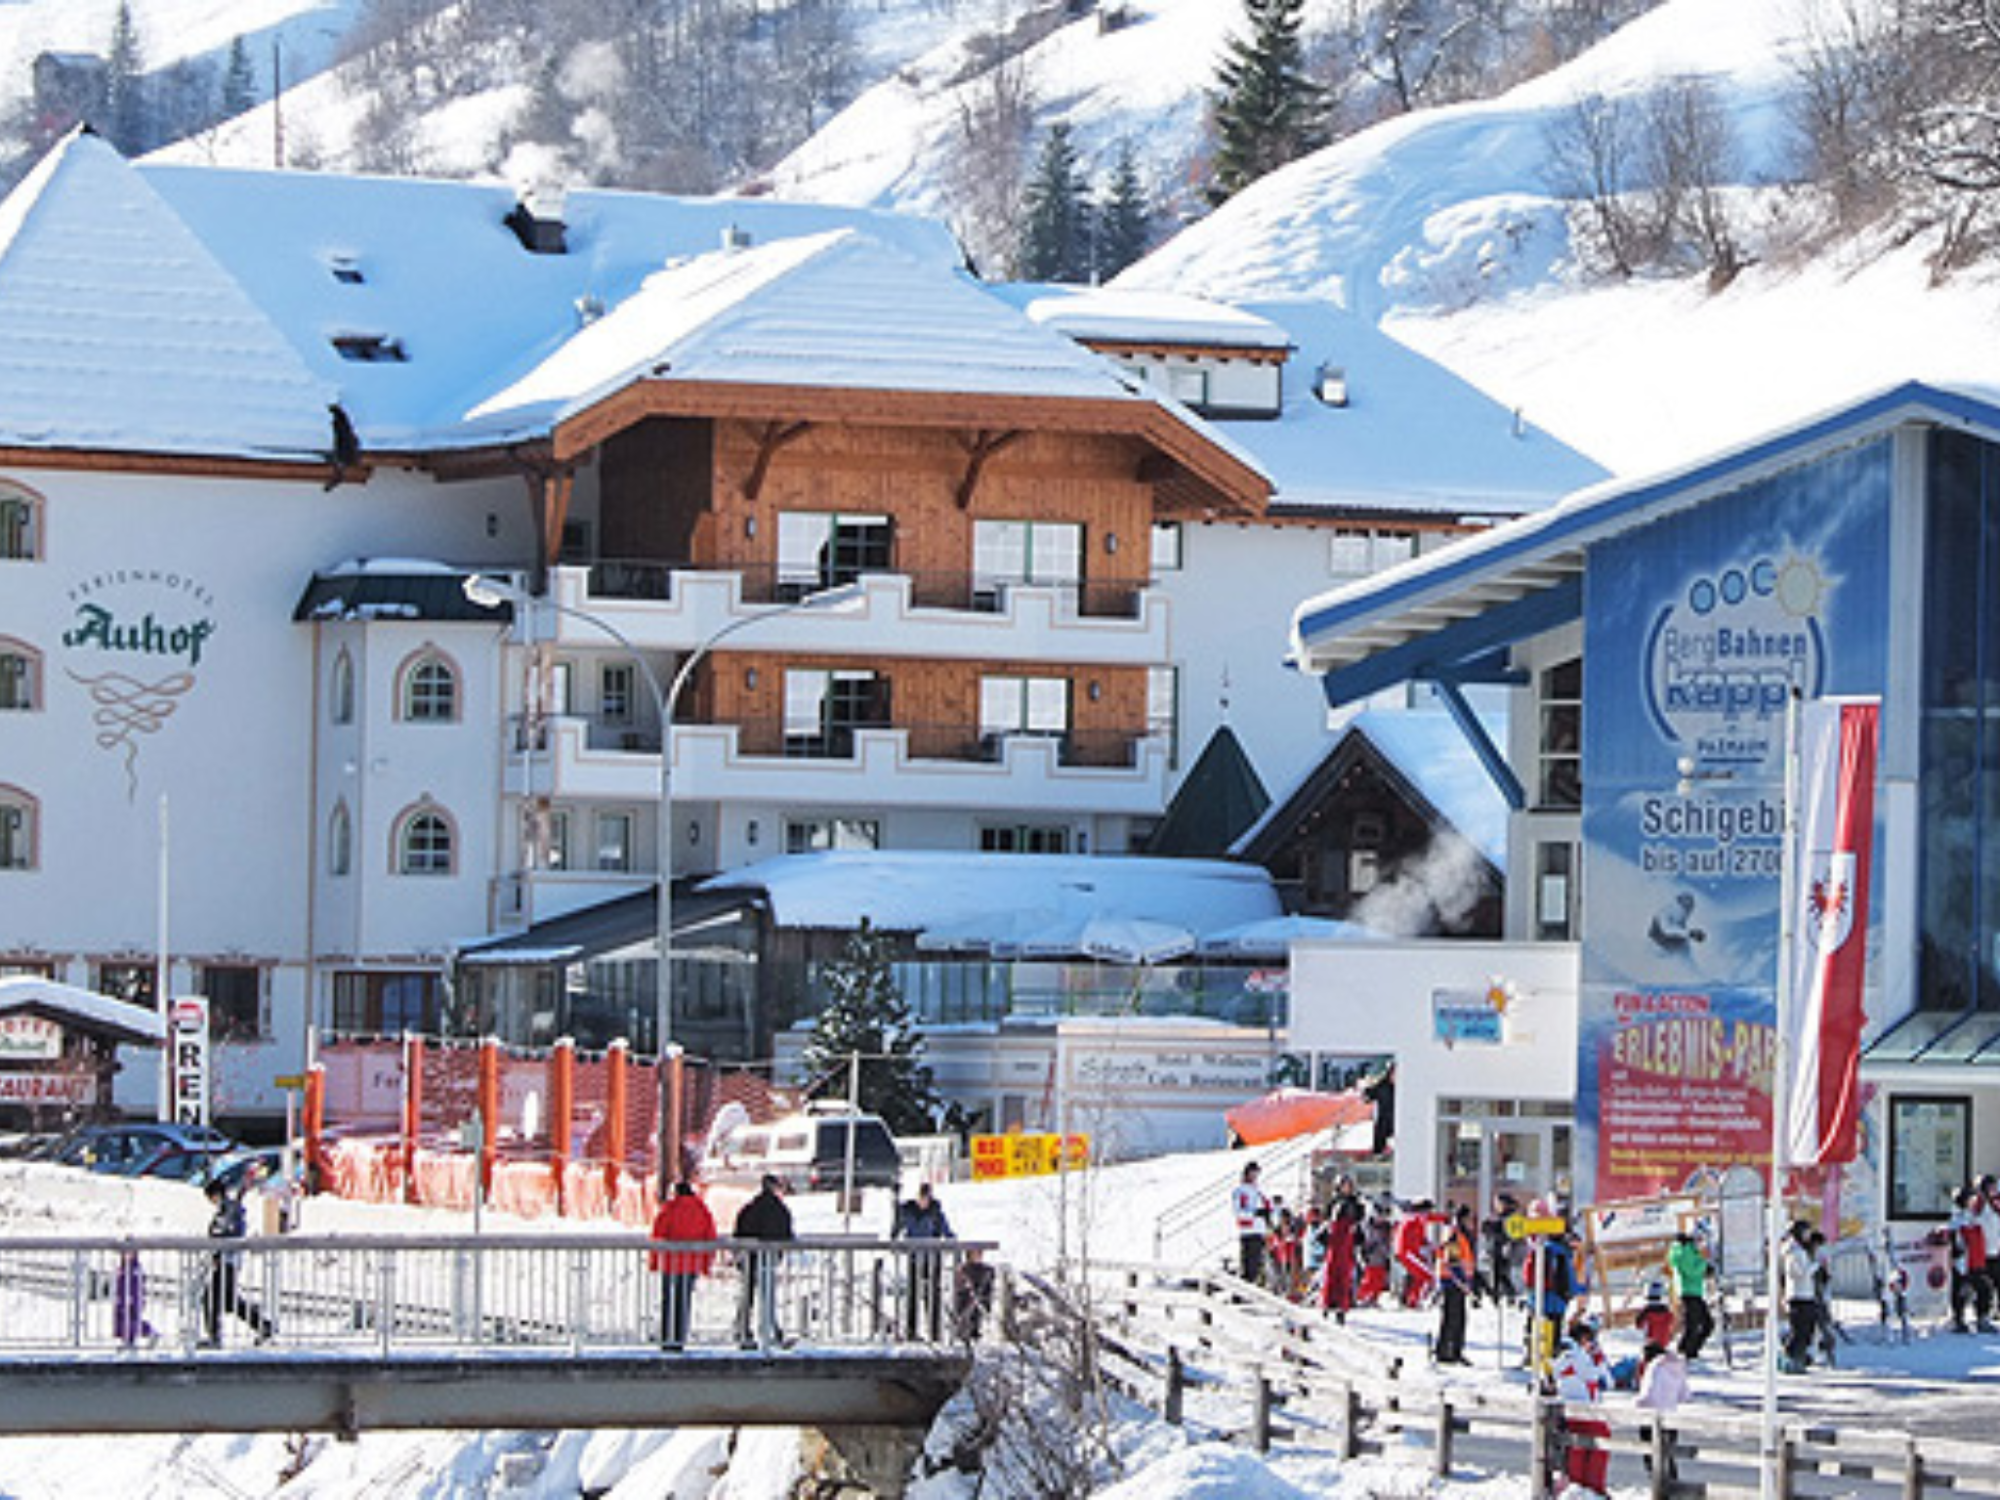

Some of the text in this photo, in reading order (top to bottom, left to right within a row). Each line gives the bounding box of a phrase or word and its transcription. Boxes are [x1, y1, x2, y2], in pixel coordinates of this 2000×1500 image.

[62, 602, 217, 667] Auhof
[1643, 800, 1786, 842] Schigebi
[1643, 850, 1678, 872] bis
[1686, 850, 1725, 872] auf
[1613, 1018, 1779, 1081] ERLEBNIS-PAR
[0, 1076, 91, 1100] AURANT
[177, 1042, 202, 1125] REN
